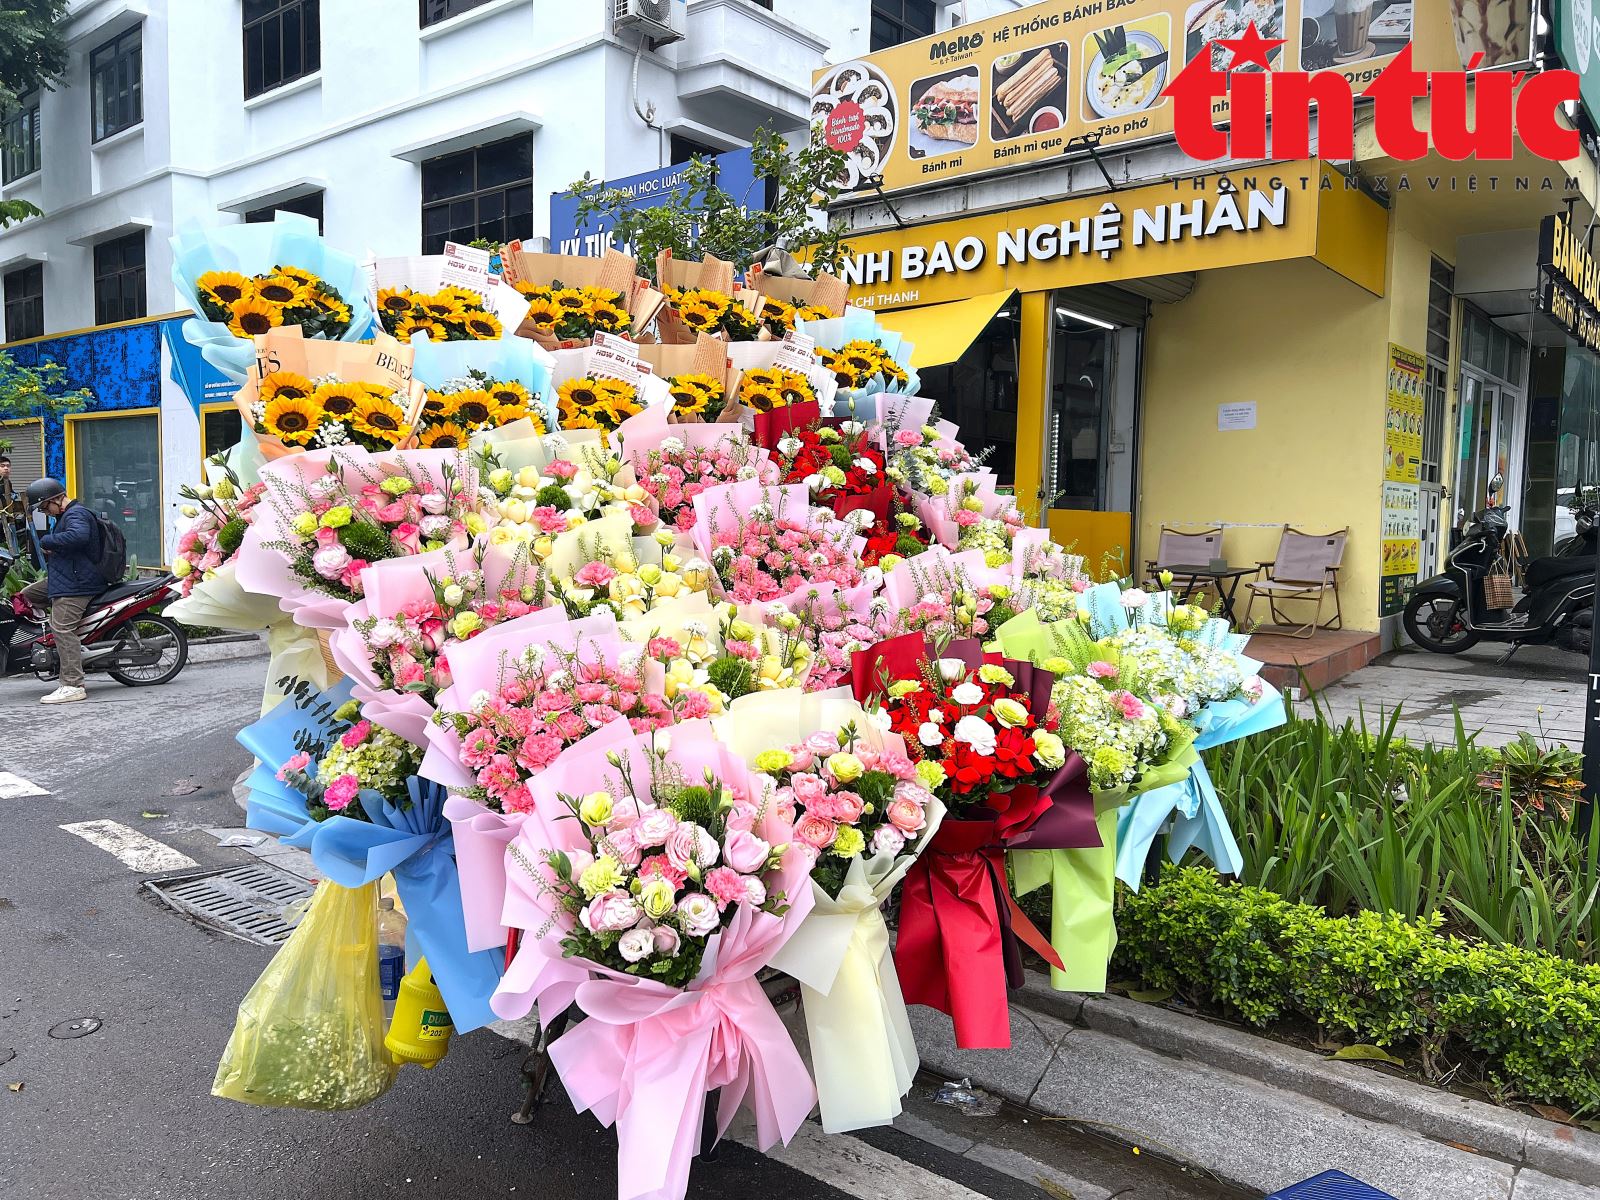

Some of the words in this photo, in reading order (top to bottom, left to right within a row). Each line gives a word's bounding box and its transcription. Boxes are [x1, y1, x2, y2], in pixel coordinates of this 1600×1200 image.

[993, 26, 1010, 42] HỆ
[1013, 14, 1059, 37] THỐNG
[1063, 3, 1103, 23] BÁNH
[951, 51, 973, 63] Taiwan
[1123, 117, 1149, 132] phớ
[993, 143, 1021, 158] Bánh
[1041, 137, 1063, 151] que
[922, 158, 947, 173] Bánh
[639, 179, 660, 195] HỌC
[661, 172, 681, 189] LUẬT
[901, 236, 986, 280] BAO
[997, 202, 1122, 265] NGHỆ
[1133, 183, 1289, 246] NHÂN
[1552, 211, 1585, 293] BÁNH
[855, 293, 875, 307] CHÍ
[877, 290, 919, 305] THANH
[595, 349, 614, 359] HOW
